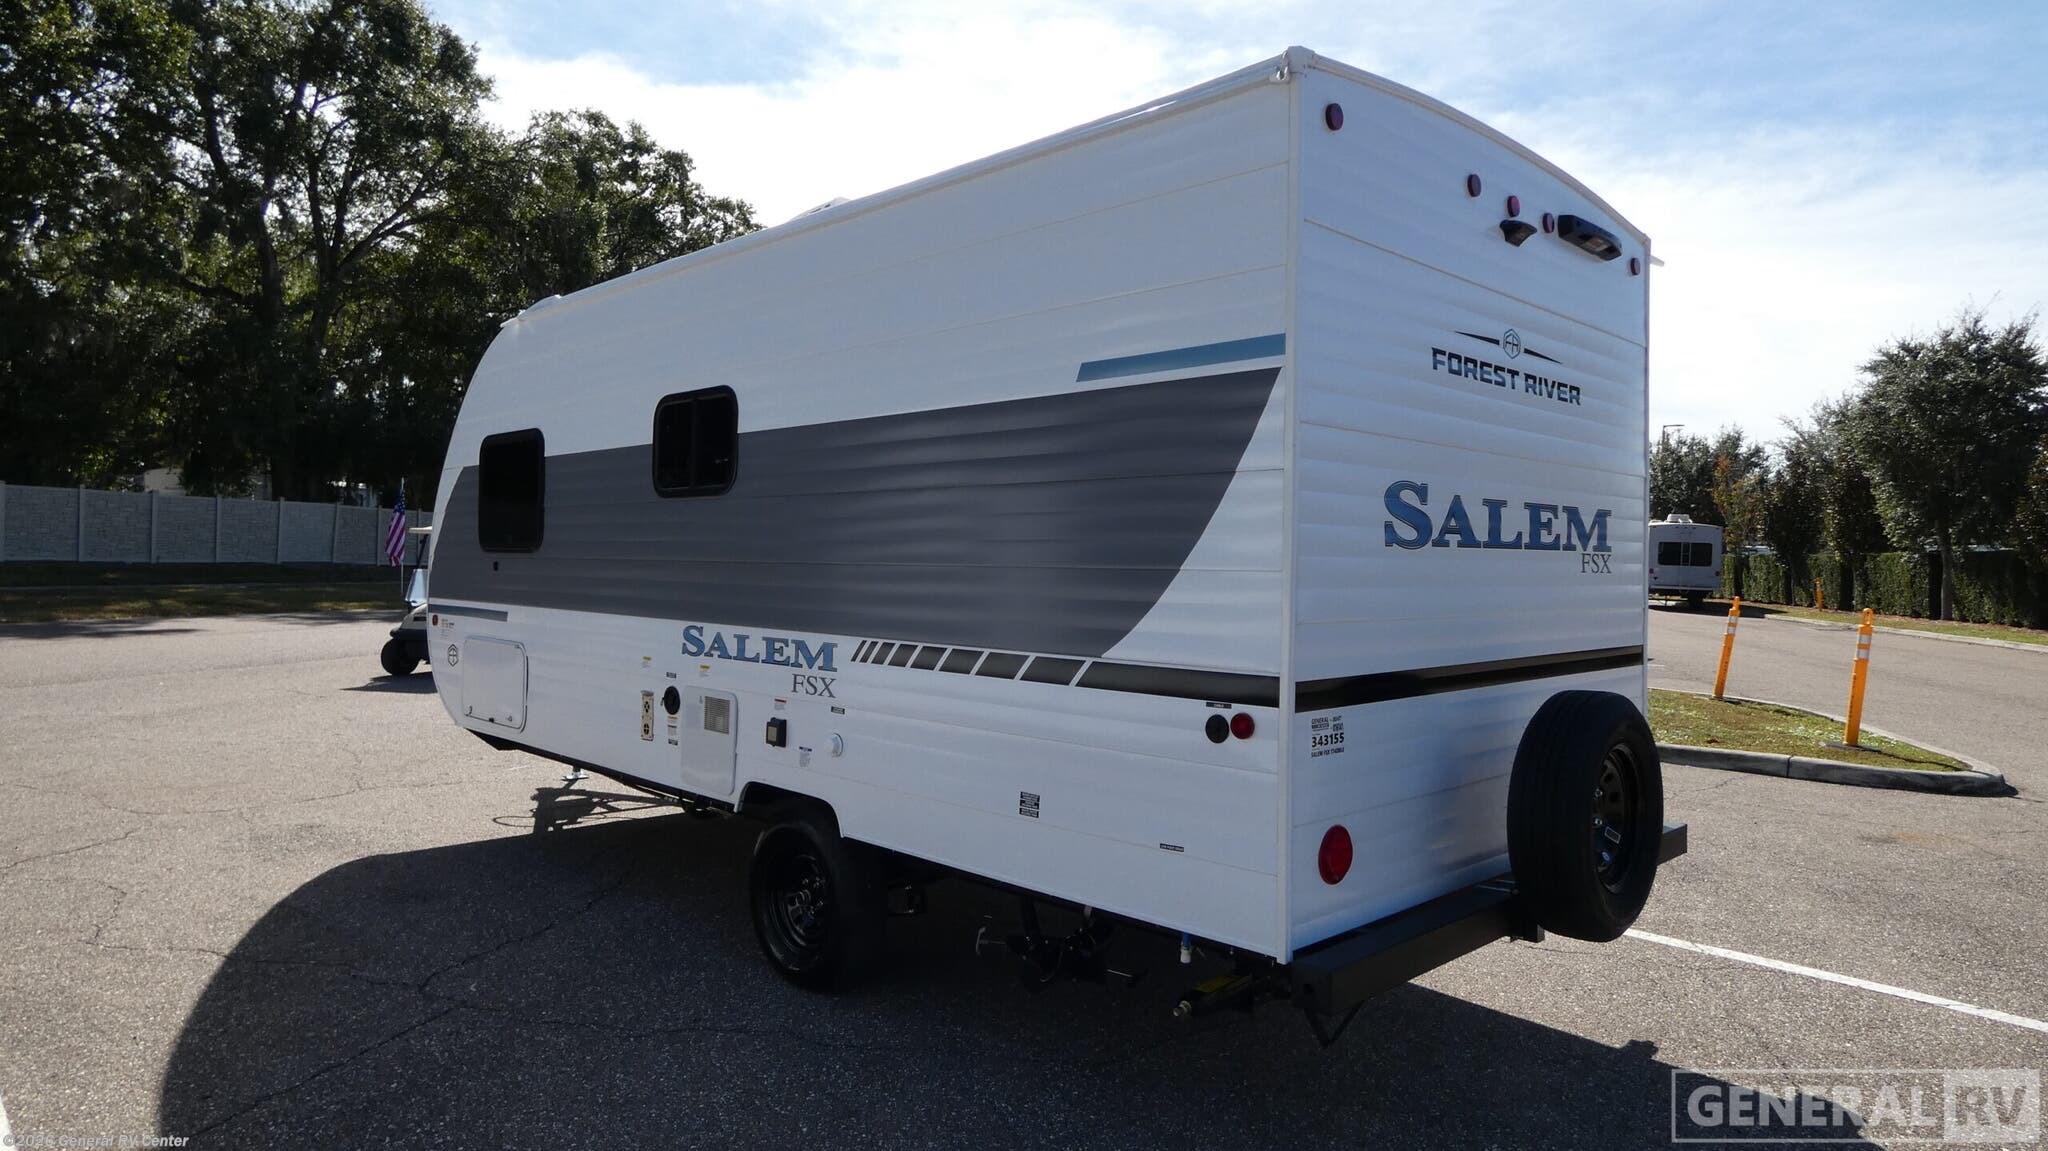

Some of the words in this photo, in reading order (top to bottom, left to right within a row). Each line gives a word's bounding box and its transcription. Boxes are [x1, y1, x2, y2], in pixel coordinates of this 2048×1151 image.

[1431, 347, 1520, 390] FOREST
[1524, 373, 1582, 406] RIVER
[1384, 480, 1612, 551] SALEM
[1581, 553, 1612, 574] FSX
[682, 625, 838, 673] SALEM
[792, 673, 837, 699] FSX
[1311, 732, 1345, 748] 343155
